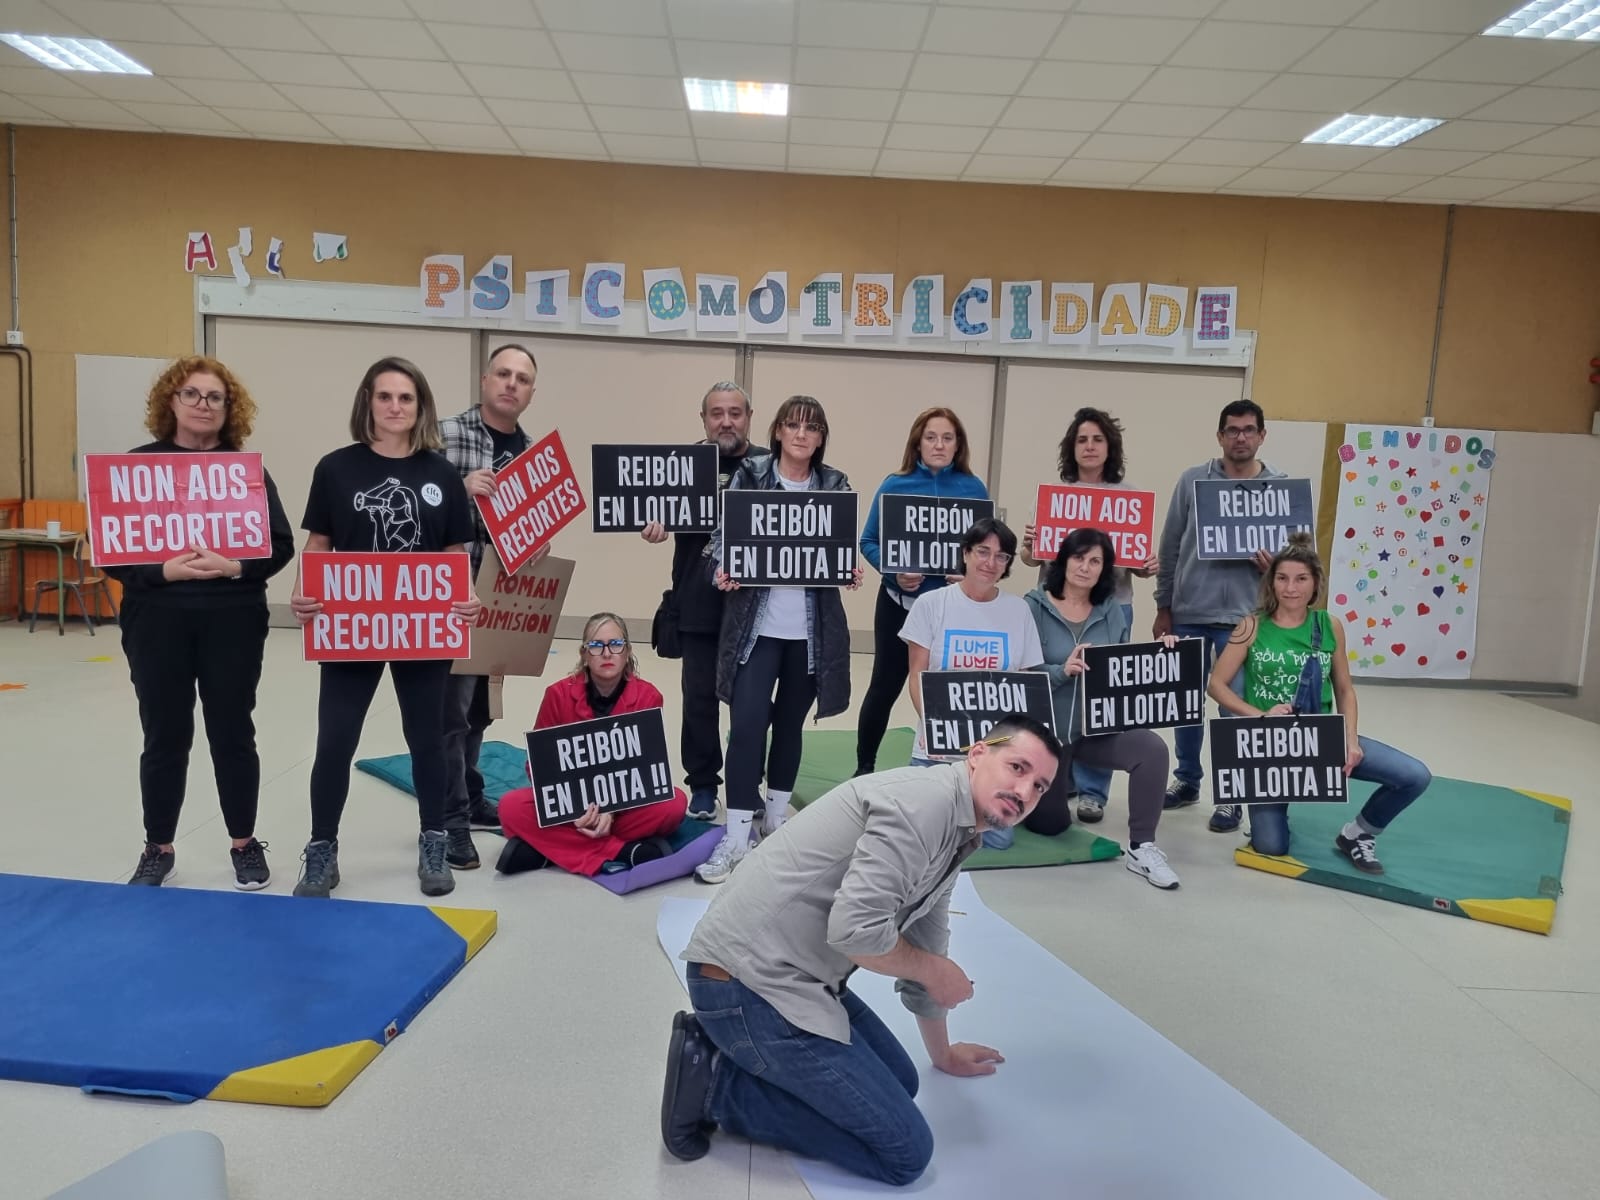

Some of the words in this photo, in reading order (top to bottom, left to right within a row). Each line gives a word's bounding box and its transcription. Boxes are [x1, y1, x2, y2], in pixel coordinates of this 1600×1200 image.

[424, 261, 1232, 341] PSICOMOTRICIDADE
[618, 450, 694, 487] REIBÓN
[1338, 430, 1496, 470] BENVIDOS
[110, 464, 175, 503] NON
[188, 463, 248, 501] AOS
[489, 471, 528, 522] NON
[525, 445, 561, 493] AOS
[1219, 484, 1291, 518] REIBÓN
[498, 477, 580, 564] RECORTES
[599, 496, 625, 527] EN
[633, 496, 693, 526] LOITA
[700, 496, 714, 526] !!
[751, 498, 833, 537] REIBÓN
[905, 503, 974, 535] REIBÓN
[1050, 493, 1092, 521] NON
[1098, 496, 1142, 525] AOS
[101, 511, 263, 554] RECORTES
[1040, 525, 1148, 561] RETES
[1203, 525, 1228, 553] EN
[729, 545, 757, 579] EN
[766, 546, 830, 580] LOITA
[837, 547, 853, 580] !!
[887, 539, 911, 568] EN
[919, 540, 961, 570] LOIT
[323, 563, 383, 602] NON
[394, 563, 452, 601] AOS
[493, 570, 559, 600] ROMAN
[313, 612, 463, 650] RECORTES
[955, 639, 1000, 655] LUME
[953, 655, 999, 669] LUME
[1108, 647, 1180, 688] REIBÓN
[947, 677, 1028, 713] REIBÓN
[1090, 696, 1116, 729] EN
[1123, 691, 1179, 726] LOITA
[1186, 689, 1199, 720] !!
[556, 722, 642, 772] REIBÓN
[931, 719, 961, 750] EN
[1236, 721, 1319, 759] REIBÓN
[541, 781, 574, 819] EN
[579, 767, 647, 811] LOITA
[650, 762, 669, 796] !!
[1218, 768, 1246, 799] EN
[1254, 766, 1319, 797] LOITA
[1326, 766, 1343, 797] !!
